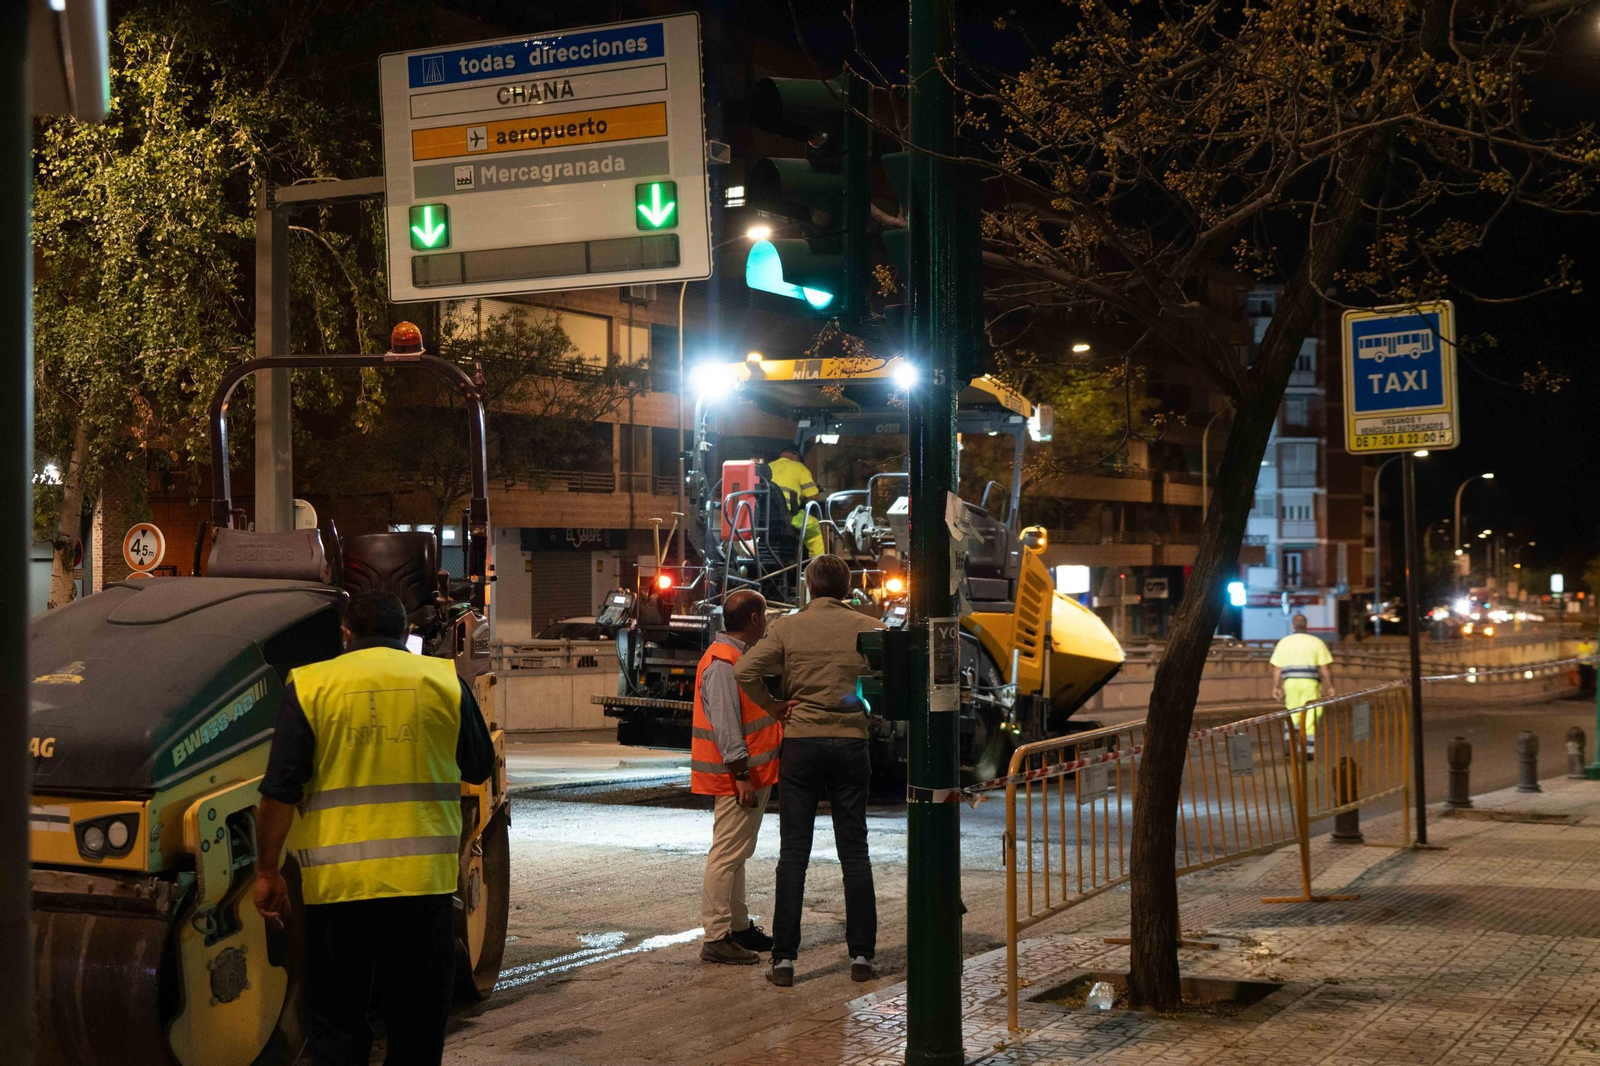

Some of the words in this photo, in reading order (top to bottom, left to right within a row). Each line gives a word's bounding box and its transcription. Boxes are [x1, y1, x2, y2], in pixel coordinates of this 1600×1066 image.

[459, 53, 516, 76] todas
[528, 36, 648, 67] direcciones
[496, 79, 575, 106] CHANA
[495, 117, 608, 149] aeropuerto
[480, 155, 626, 186] Mercagranada
[792, 370, 819, 380] NILA
[1367, 369, 1428, 395] TAXI
[1356, 437, 1368, 448] DE
[1398, 434, 1405, 444] A
[566, 529, 575, 542] EL
[233, 694, 255, 722] AD
[29, 737, 56, 758] AG
[347, 722, 418, 748] NILA
